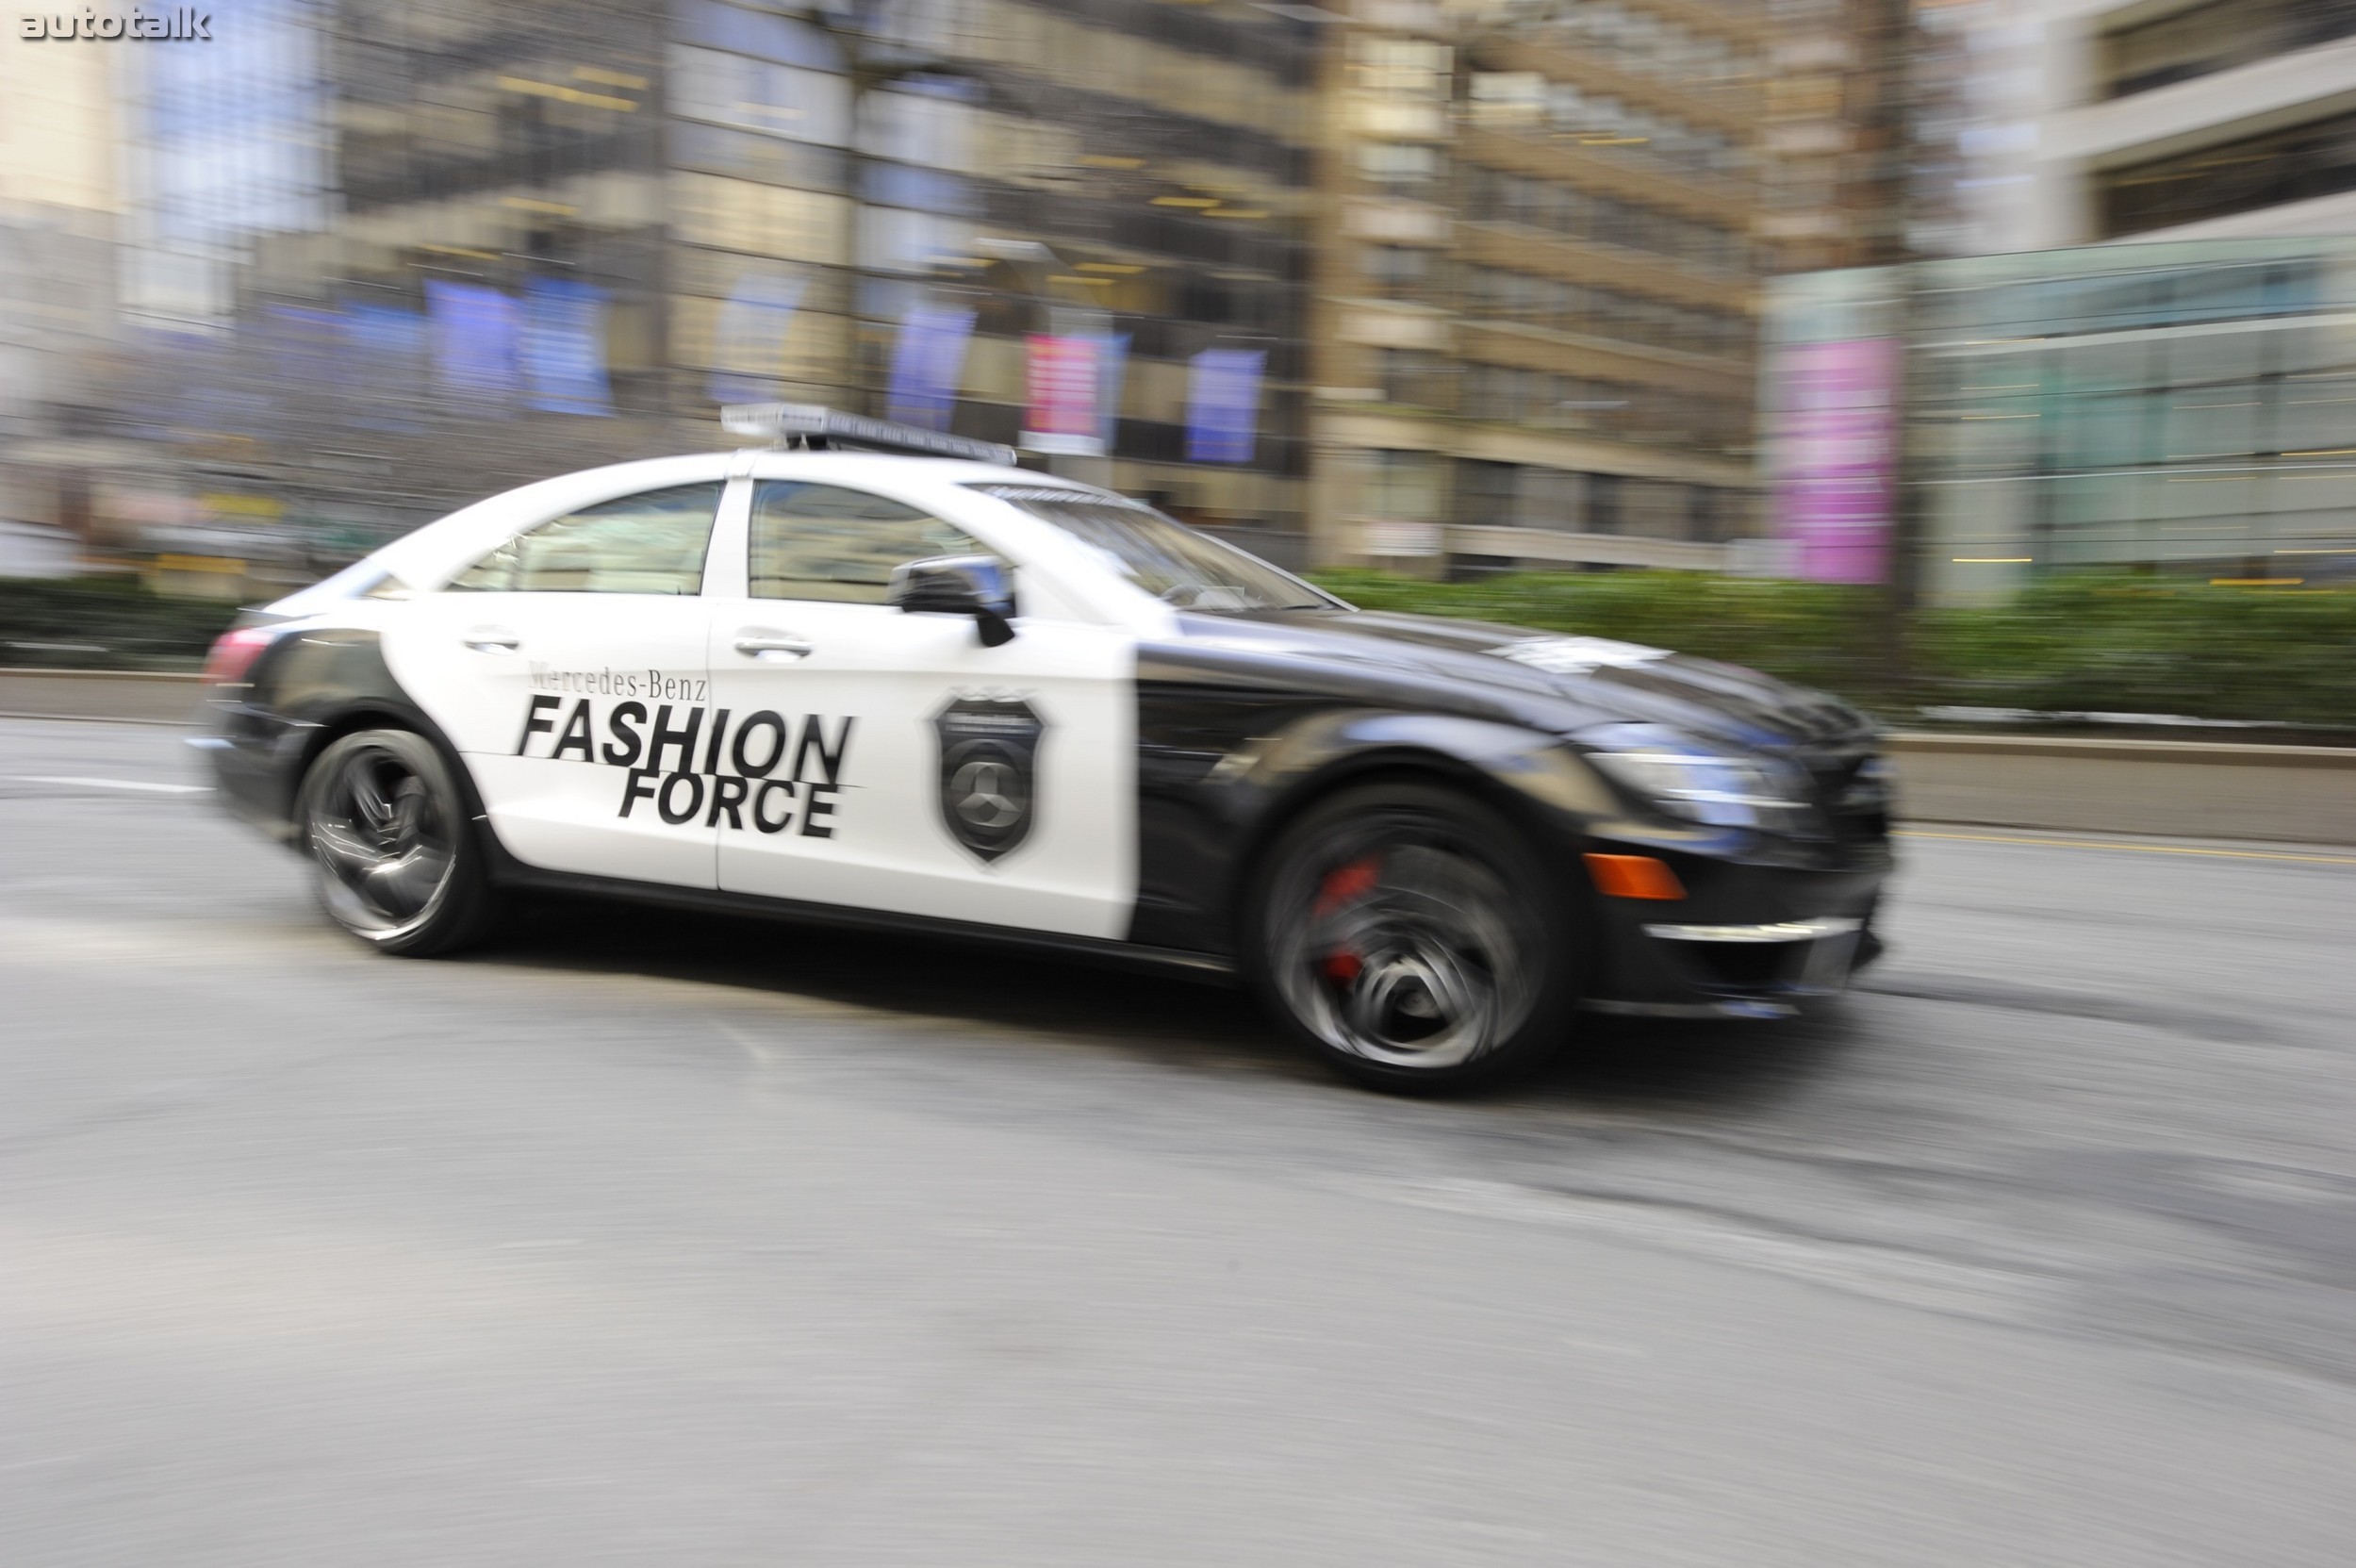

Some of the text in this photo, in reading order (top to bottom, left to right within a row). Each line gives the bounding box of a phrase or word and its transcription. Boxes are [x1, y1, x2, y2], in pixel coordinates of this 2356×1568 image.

[528, 661, 707, 701] Mercedes-Benz
[516, 694, 859, 784] FASHION
[618, 767, 840, 839] FORCE
